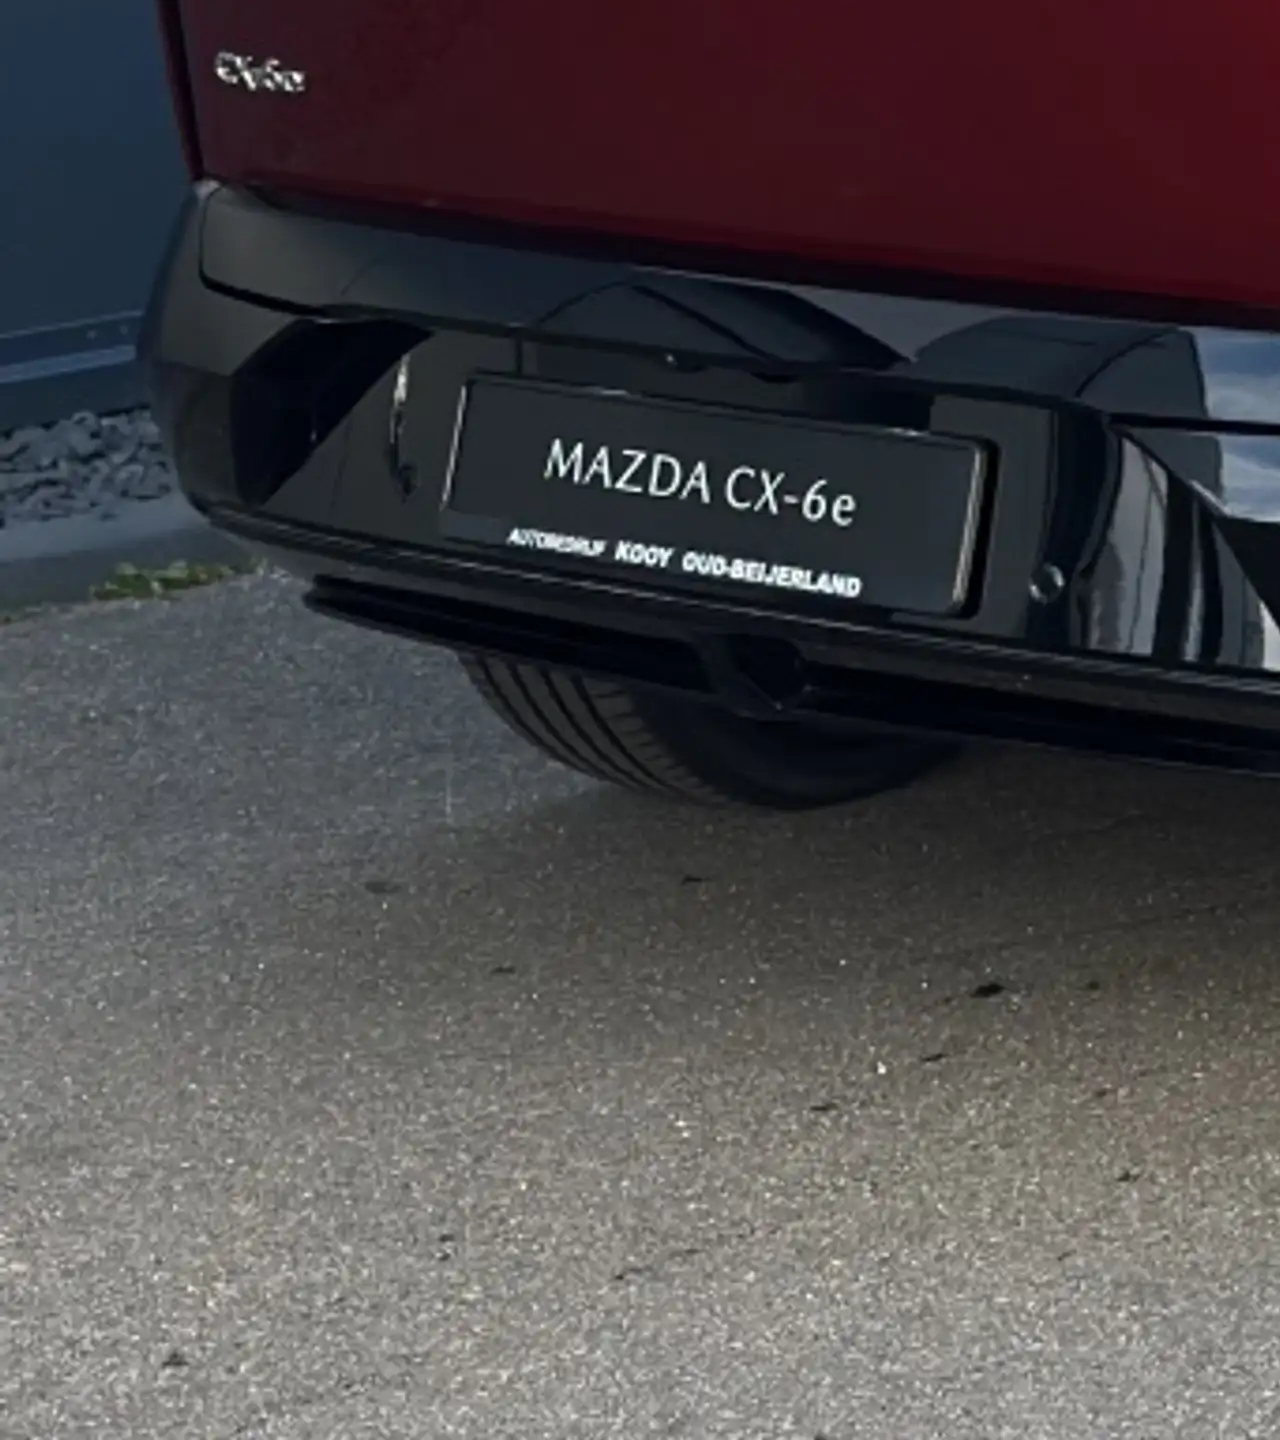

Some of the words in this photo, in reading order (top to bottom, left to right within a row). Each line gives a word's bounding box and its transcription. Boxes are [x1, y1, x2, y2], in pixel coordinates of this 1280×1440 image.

[543, 437, 711, 504] MAZDA
[724, 465, 857, 527] CX-6e
[614, 539, 674, 568] KOOY
[681, 550, 863, 598] OUD-BEIJERLAND
